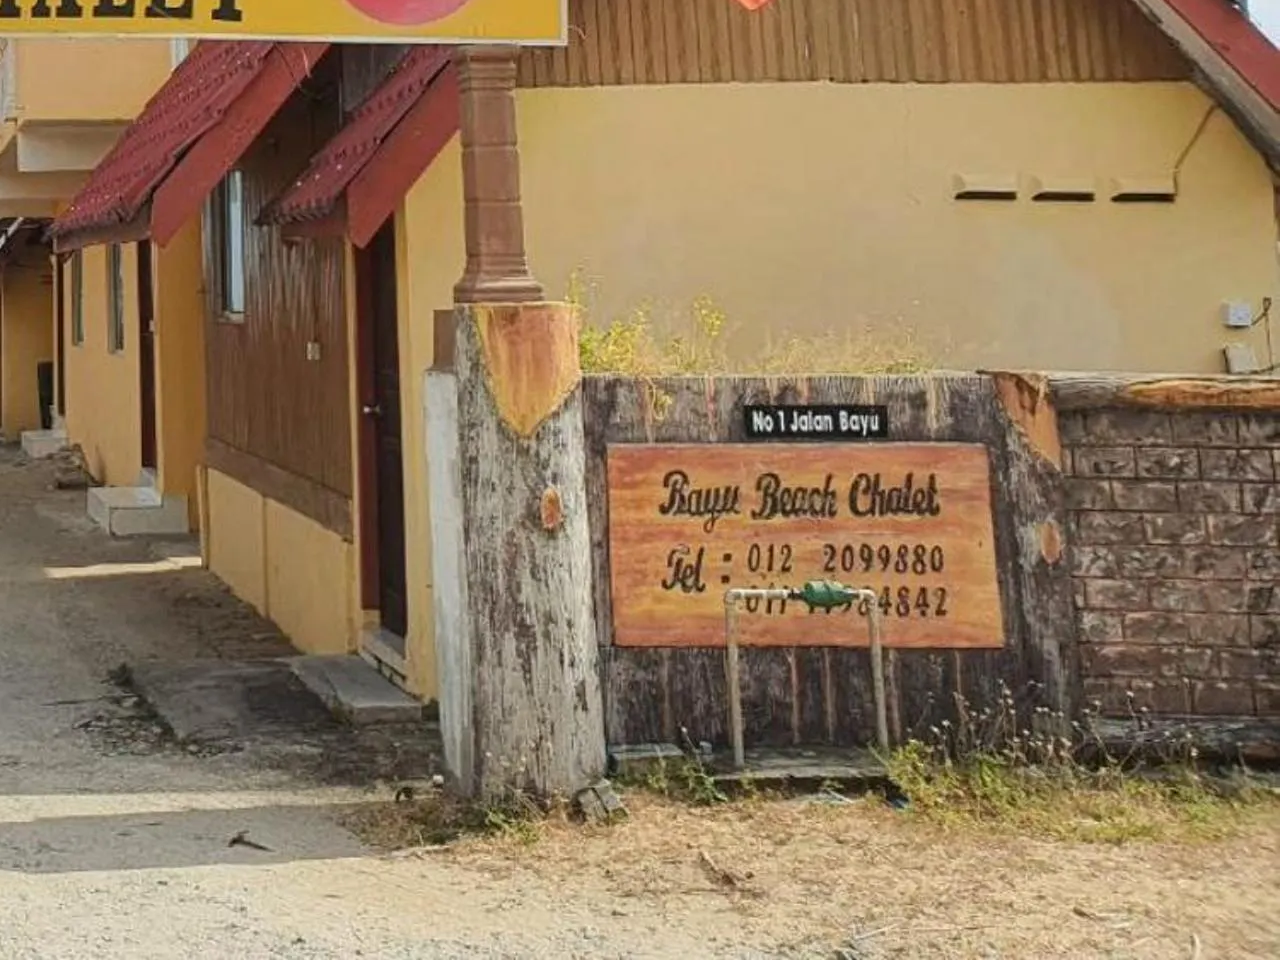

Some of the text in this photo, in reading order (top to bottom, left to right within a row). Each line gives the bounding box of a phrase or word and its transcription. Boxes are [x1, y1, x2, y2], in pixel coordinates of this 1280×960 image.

[752, 410, 879, 436] No 1 Jalan Bayu
[659, 470, 941, 533] Bayu Beach Chalet
[747, 543, 792, 573] 012
[823, 544, 945, 575] 2099880
